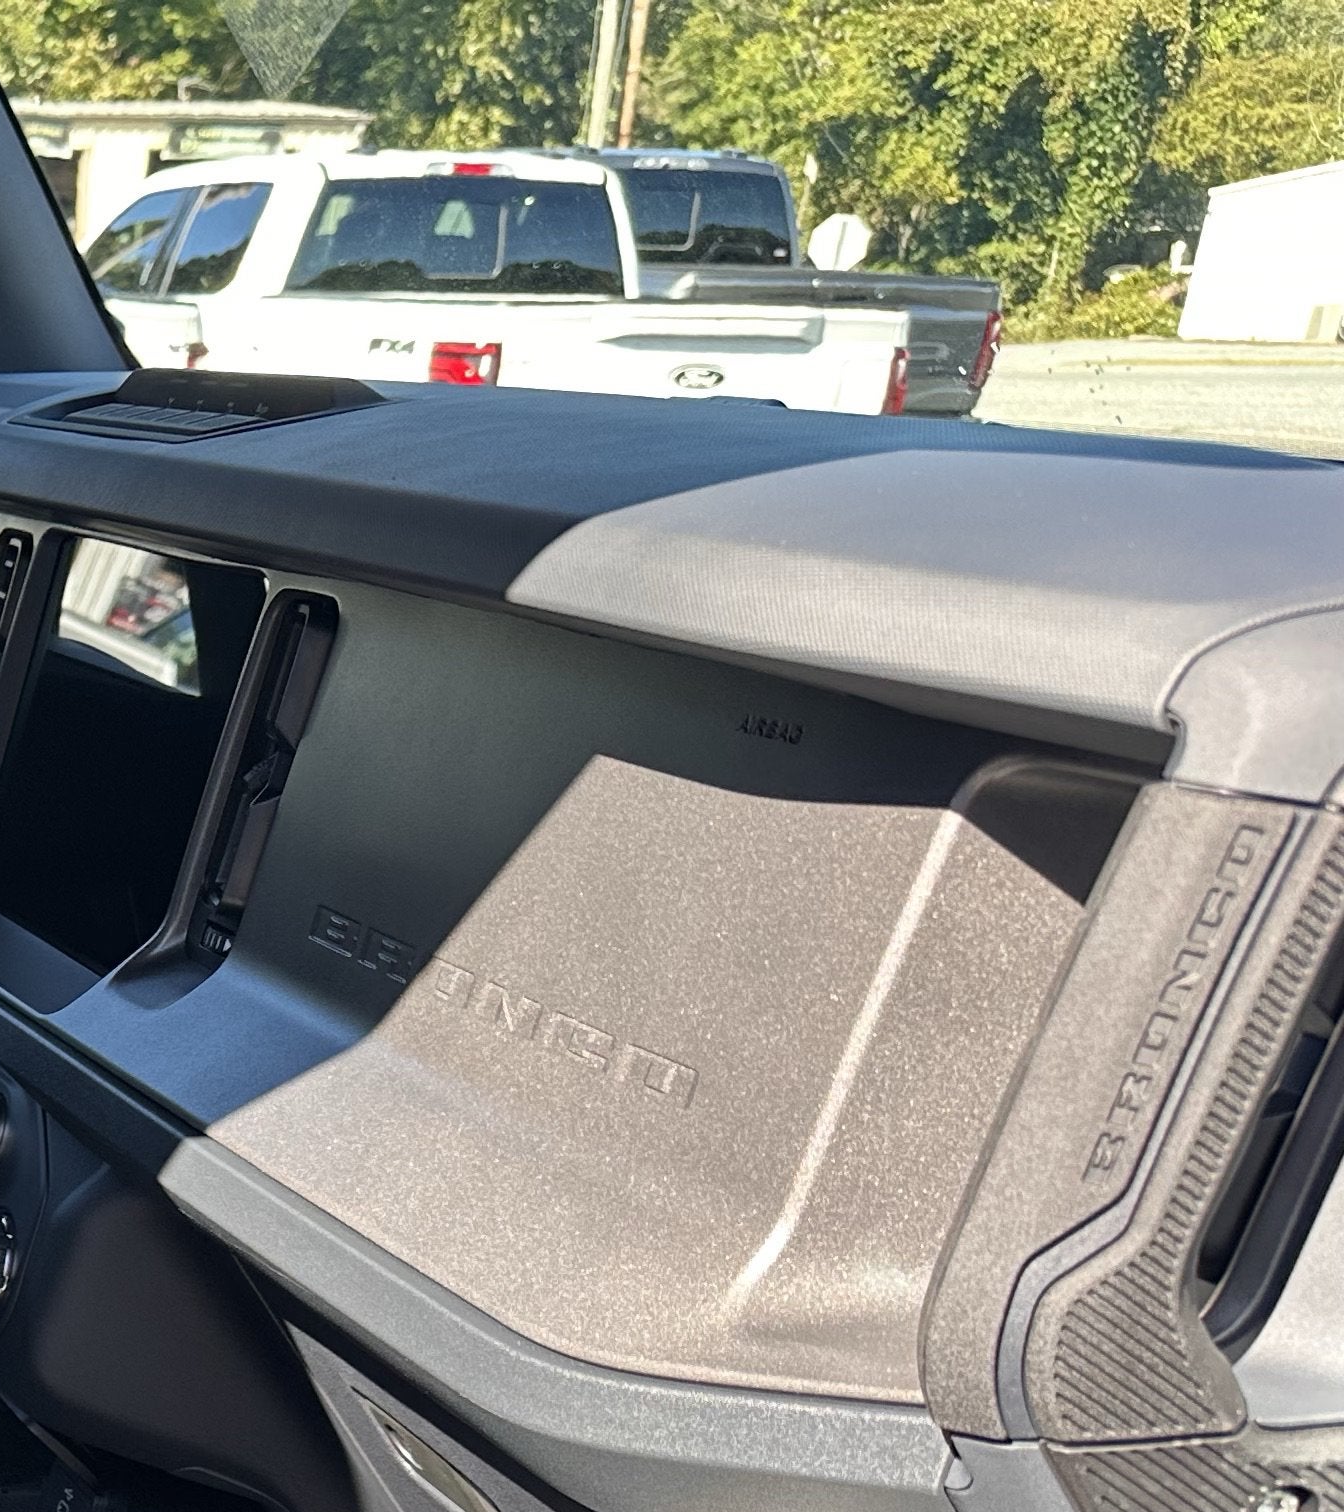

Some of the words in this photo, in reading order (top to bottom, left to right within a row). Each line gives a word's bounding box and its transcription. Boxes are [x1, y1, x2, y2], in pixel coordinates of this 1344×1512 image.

[735, 713, 805, 745] AIRBAG
[308, 904, 699, 1109] BRONCO
[1081, 823, 1264, 1182] BRONCO
